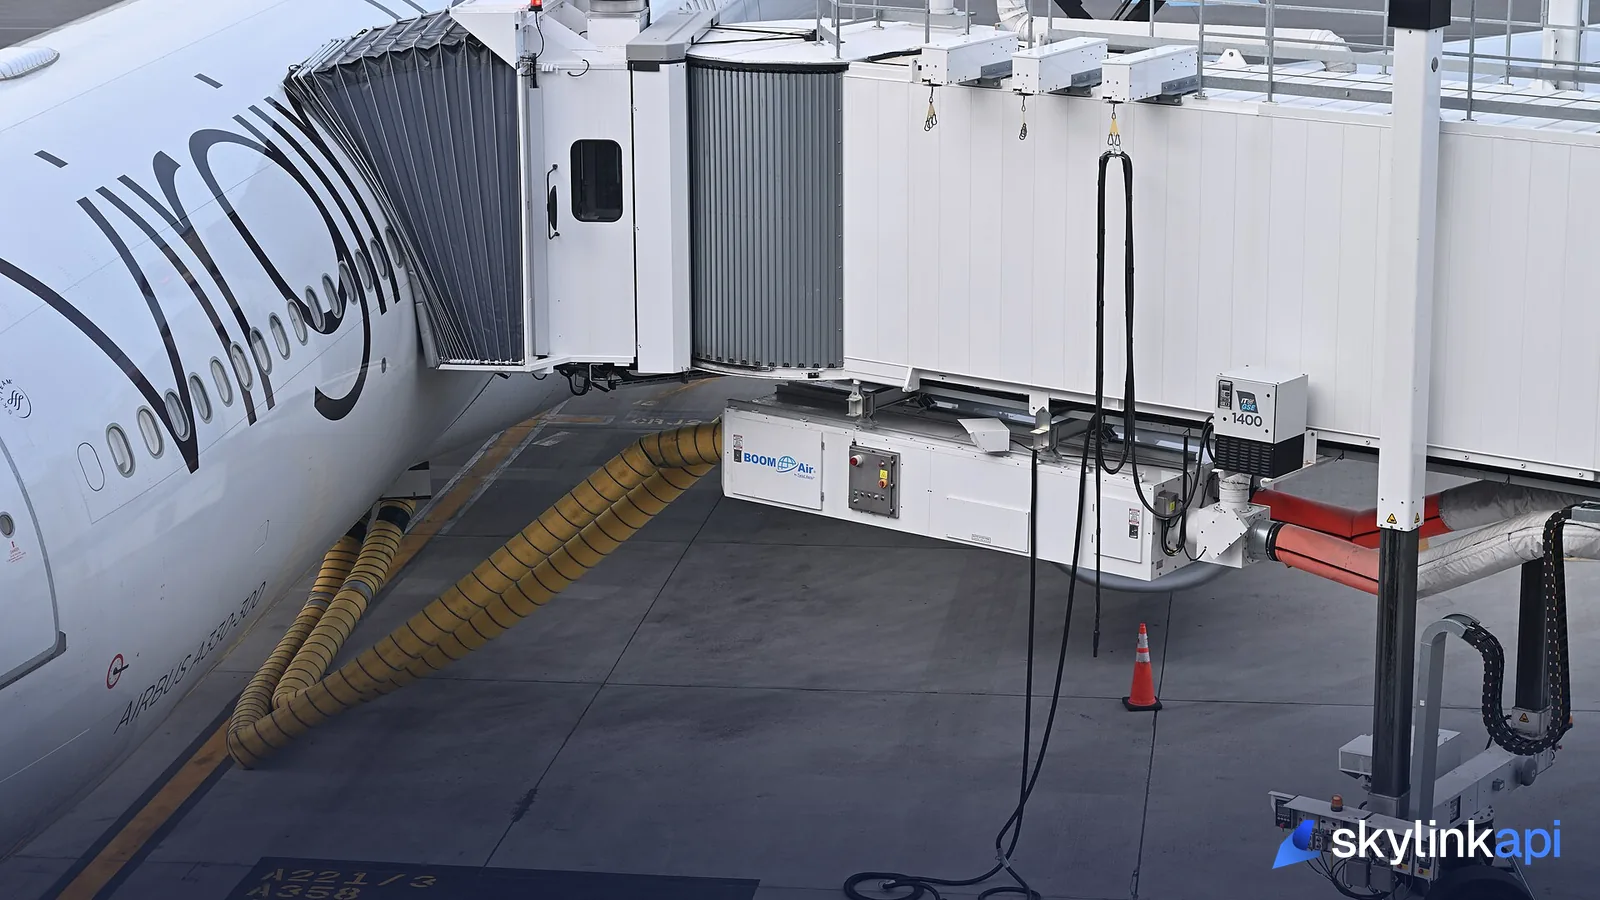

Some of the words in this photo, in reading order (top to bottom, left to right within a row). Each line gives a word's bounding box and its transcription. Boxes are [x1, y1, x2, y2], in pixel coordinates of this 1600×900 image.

[1231, 412, 1263, 427] 1400
[743, 452, 777, 467] BOOM
[797, 462, 814, 474] Air
[113, 653, 192, 735] AIRBUS
[187, 580, 266, 675] A330-300
[246, 883, 361, 900] A358
